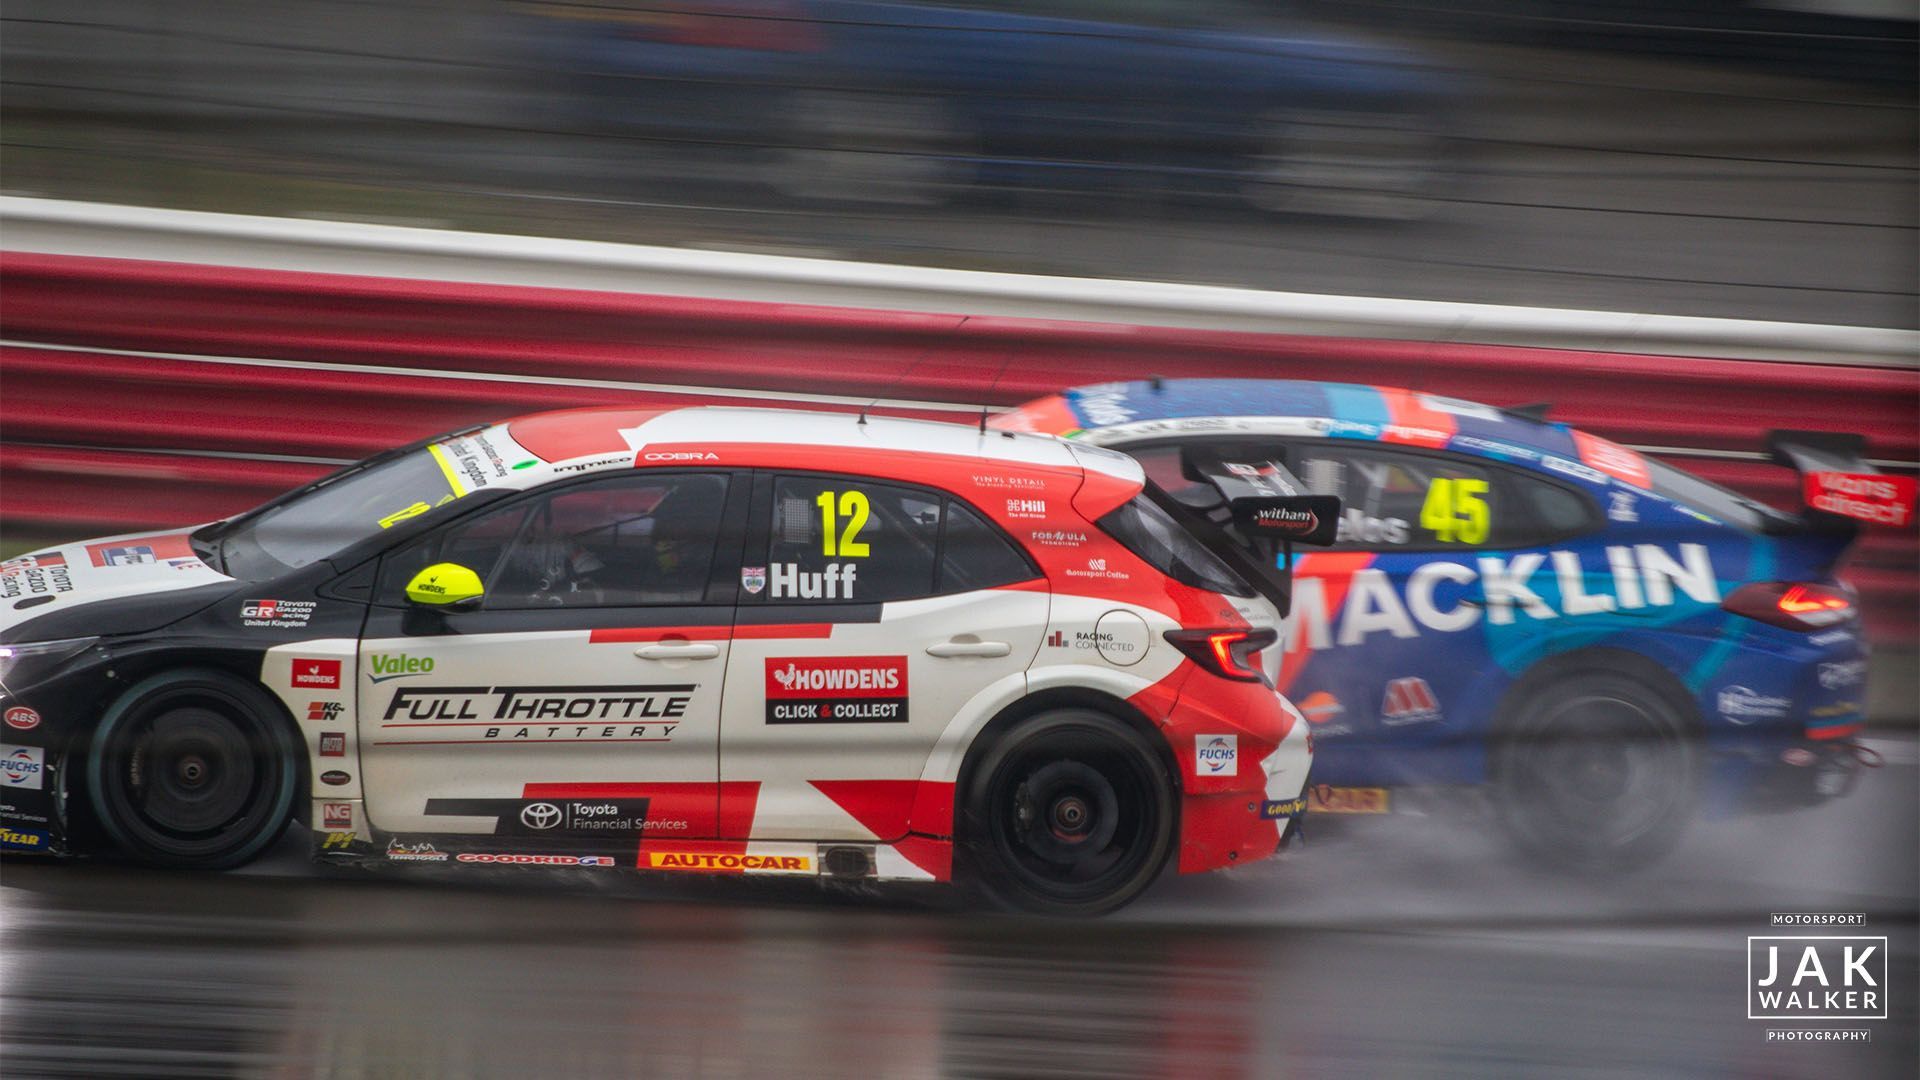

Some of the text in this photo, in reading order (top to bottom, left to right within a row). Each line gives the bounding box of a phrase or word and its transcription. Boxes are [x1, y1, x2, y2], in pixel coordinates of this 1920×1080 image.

[645, 452, 719, 461] COBRA
[1021, 500, 1046, 512] Hill
[1420, 478, 1490, 544] 45
[1259, 508, 1311, 521] witham
[816, 490, 871, 557] 12
[1258, 519, 1309, 529] Motorsport
[25, 567, 48, 593] GAZOO
[49, 565, 73, 593] TOYOTA
[770, 563, 857, 599] Huff
[243, 606, 274, 617] GR
[271, 620, 307, 629] Kingdom
[1076, 632, 1114, 641] RACING
[1075, 640, 1135, 652] CONNECTED
[372, 654, 434, 674] Valeo
[796, 668, 900, 690] HOWDENS
[383, 684, 697, 720] FULL THROTTLE
[10, 712, 36, 723] ABS
[774, 703, 899, 719] CLICK & COLLECT
[485, 726, 676, 738] BATTERY
[1200, 749, 1234, 760] FUCHS
[0, 759, 39, 773] FUCHS
[325, 804, 350, 819] NG
[574, 803, 618, 817] Toyota
[574, 819, 688, 830] Financial Services
[457, 853, 615, 867] GOODRIDGE
[661, 854, 802, 870] AUTOCAR
